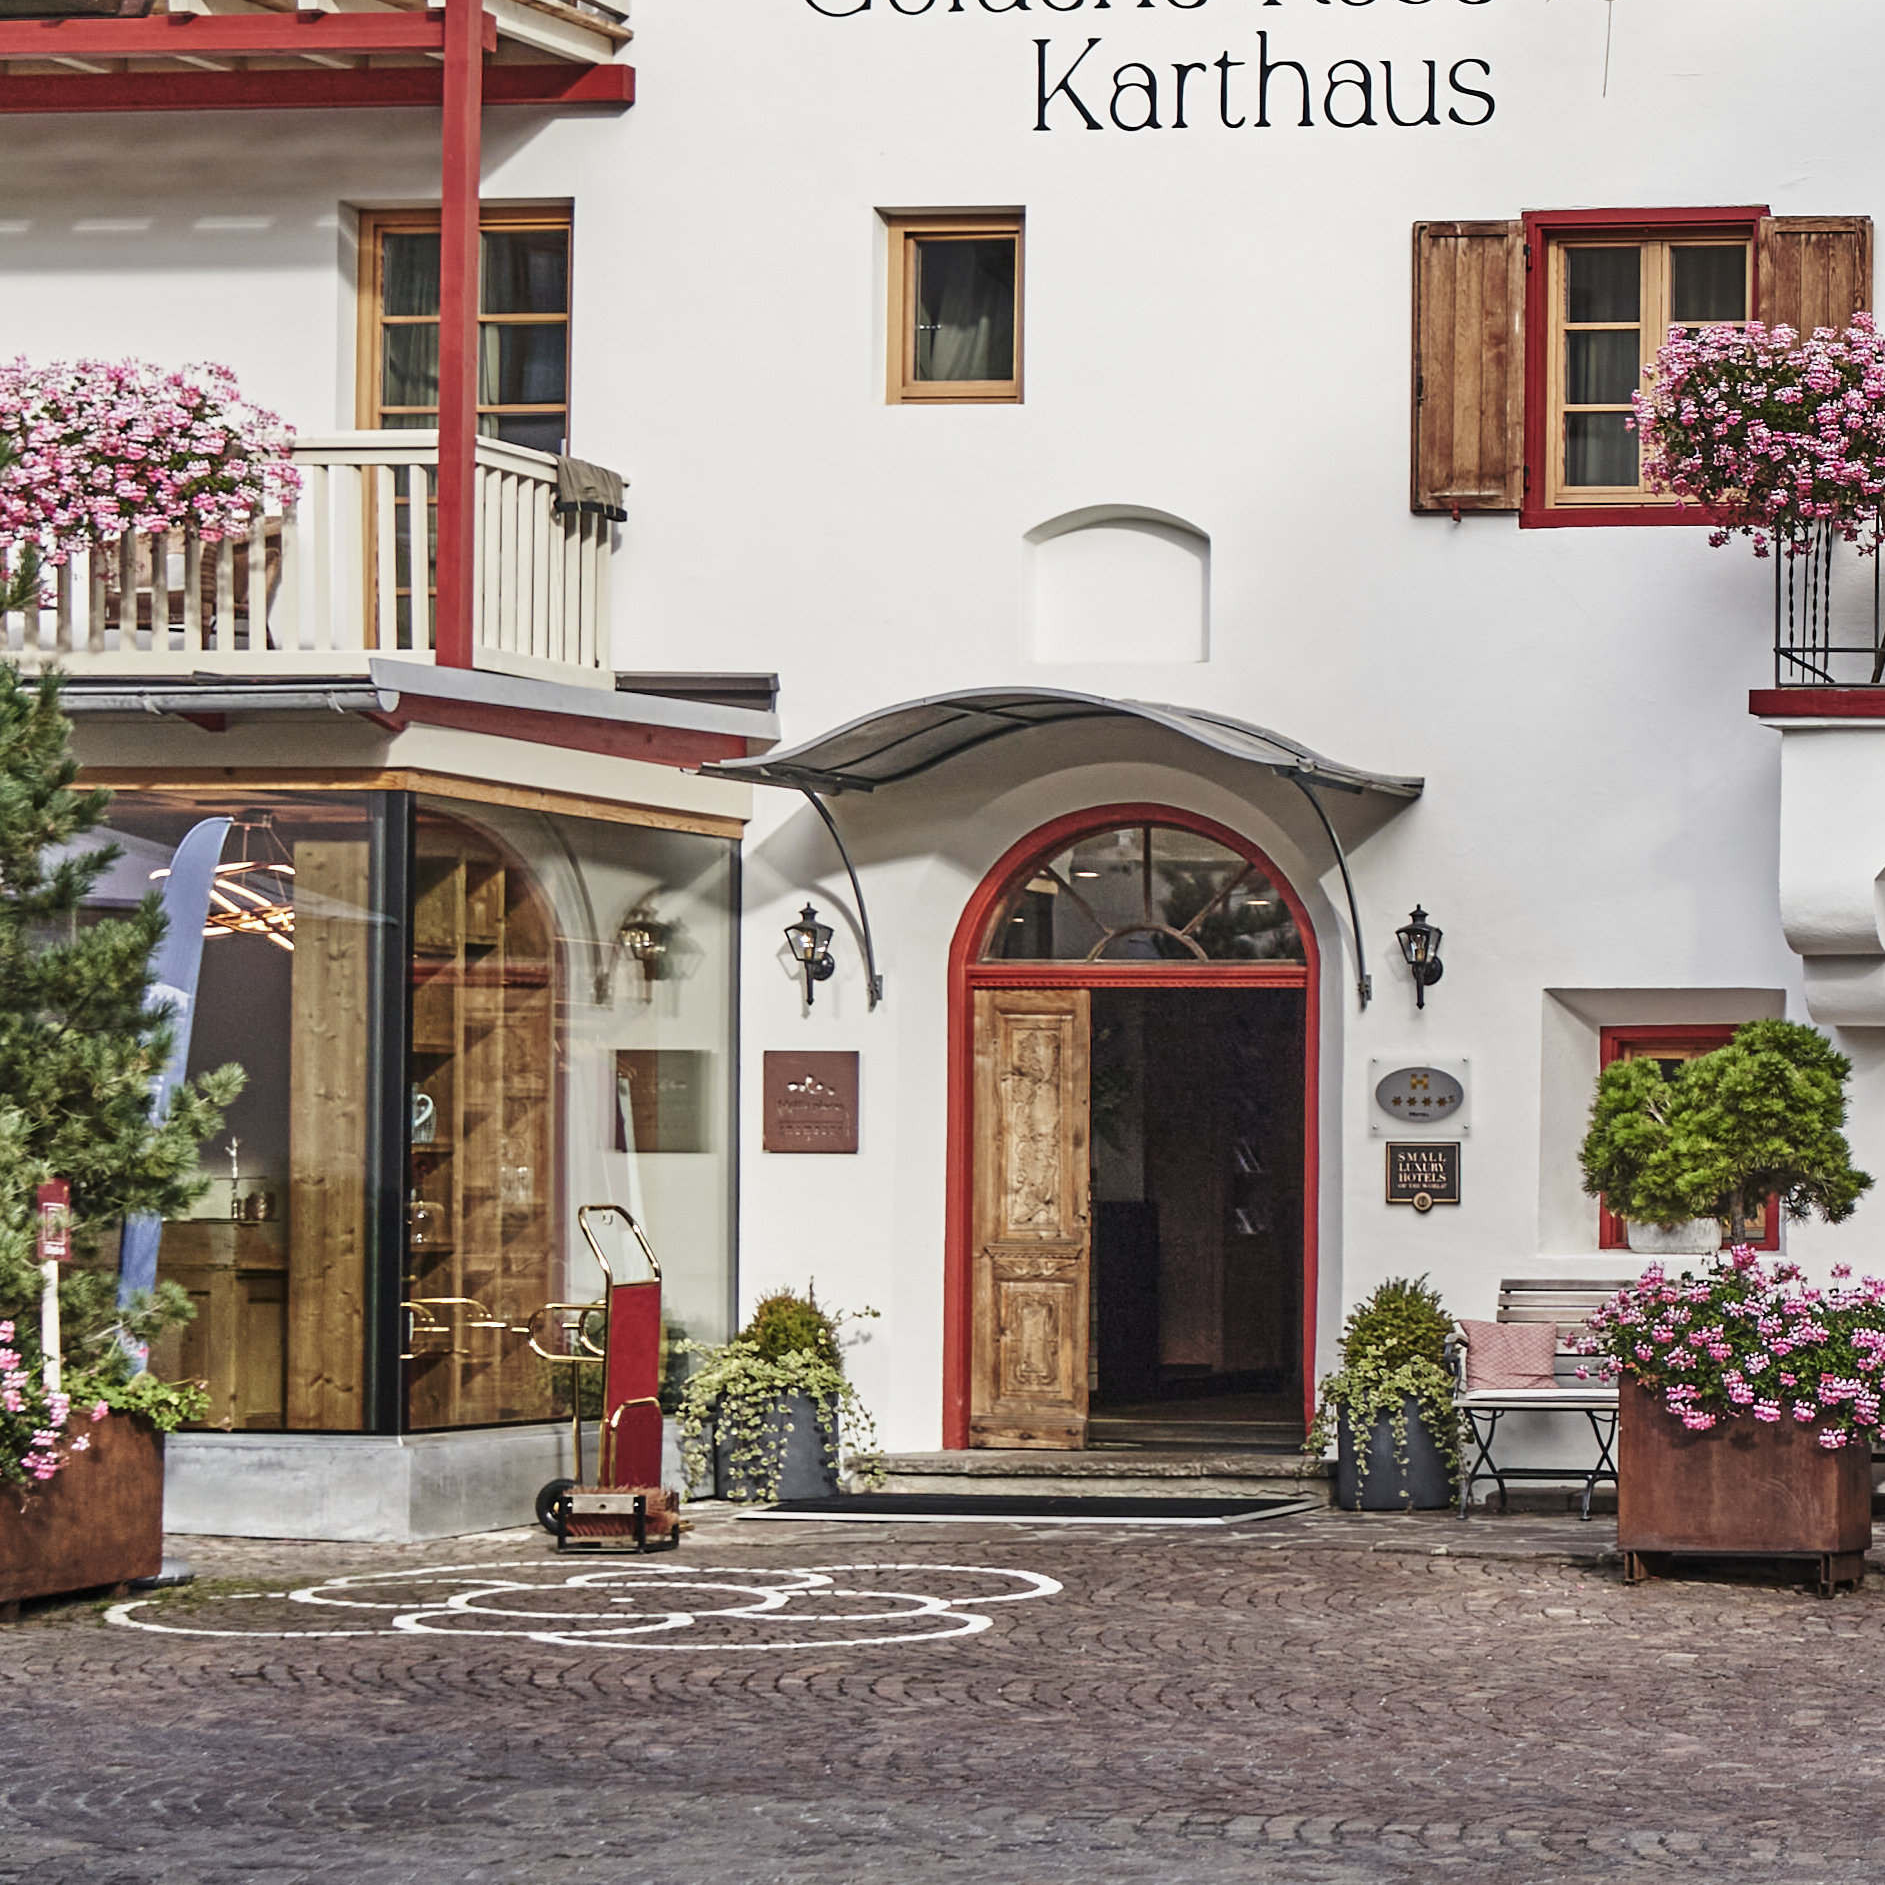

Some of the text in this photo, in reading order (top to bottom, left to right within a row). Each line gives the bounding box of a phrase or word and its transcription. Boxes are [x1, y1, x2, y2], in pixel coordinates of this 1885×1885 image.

[1033, 31, 1495, 131] Karthaus
[1398, 1152, 1446, 1162] SMALL
[1399, 1163, 1444, 1172] LUXURY
[1399, 1173, 1447, 1182] HOTELS
